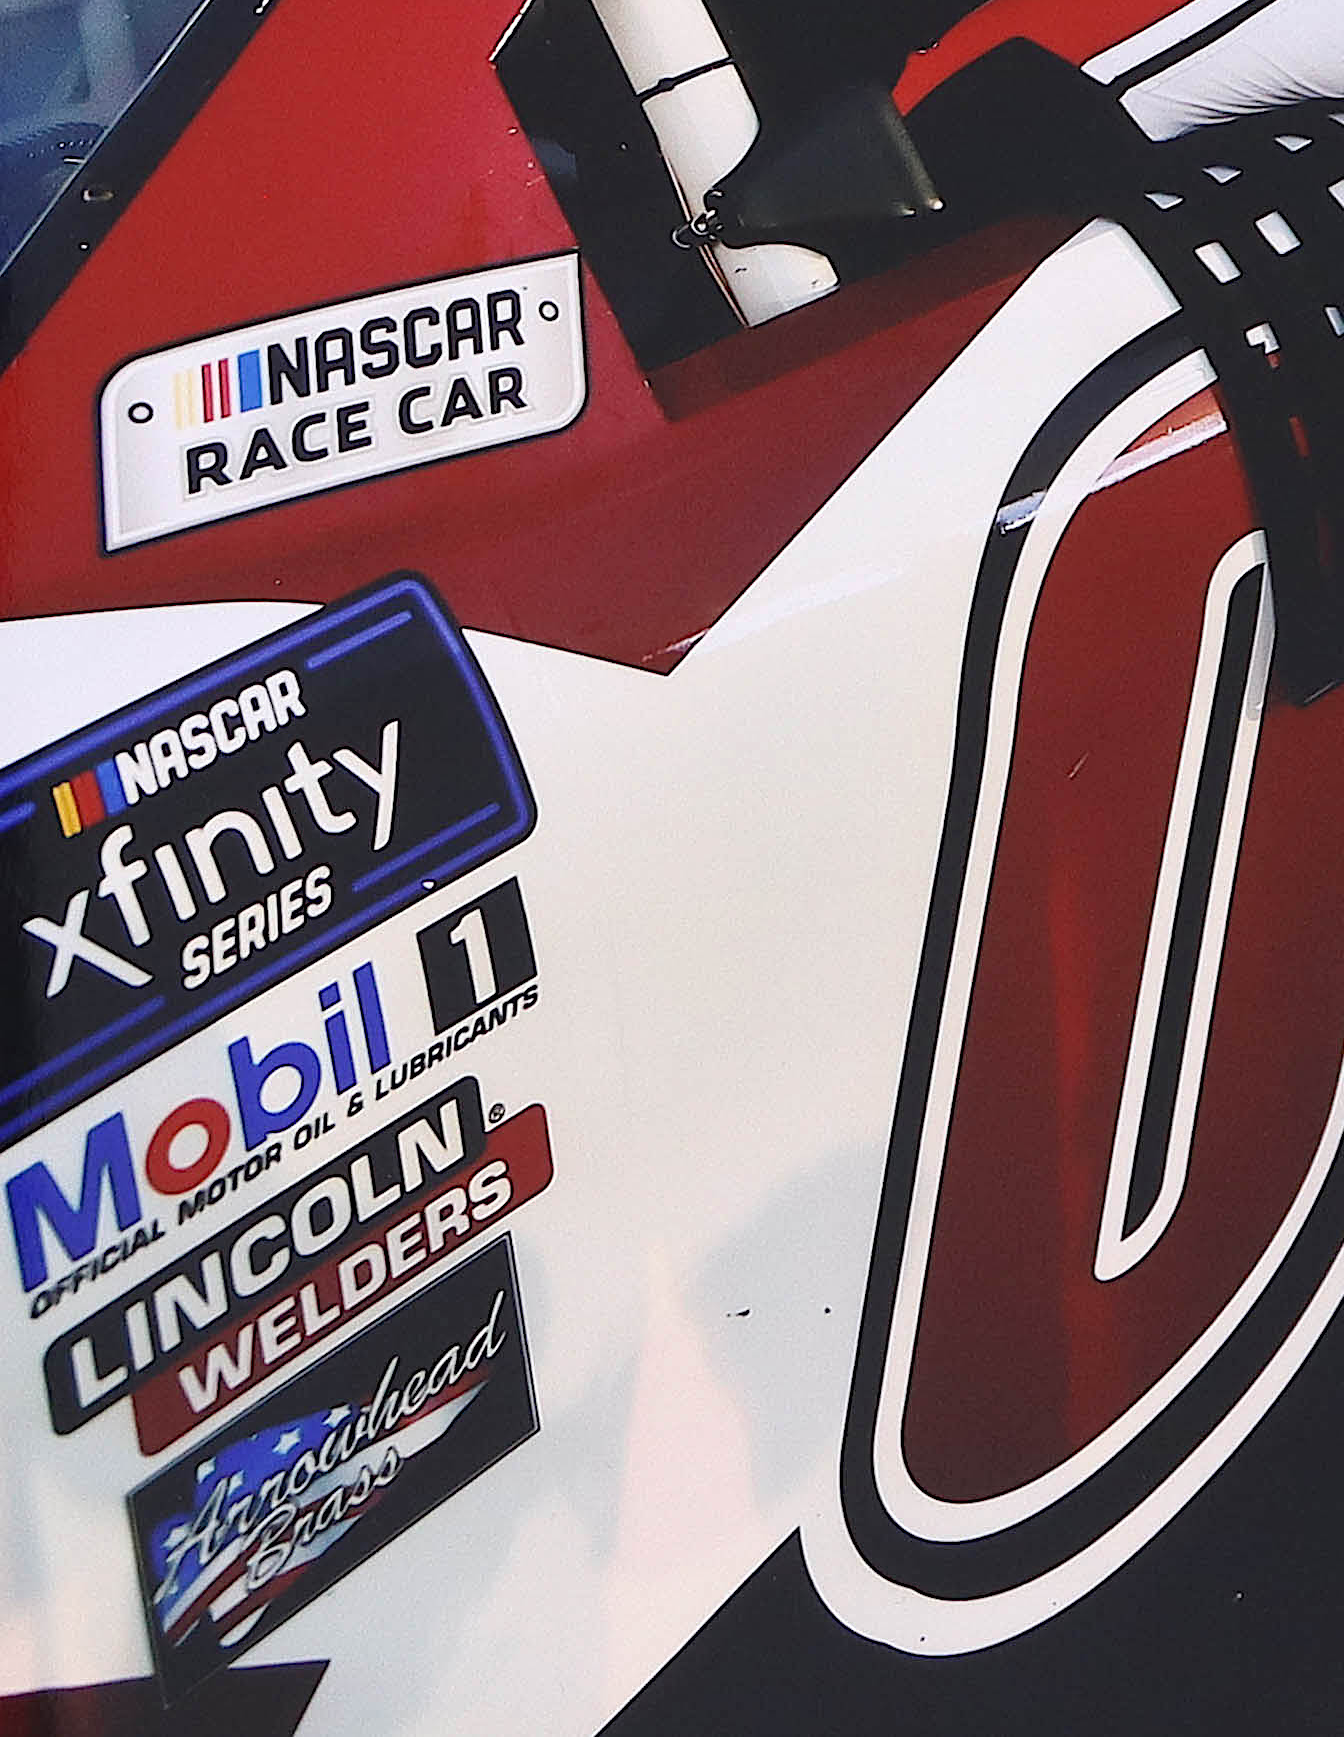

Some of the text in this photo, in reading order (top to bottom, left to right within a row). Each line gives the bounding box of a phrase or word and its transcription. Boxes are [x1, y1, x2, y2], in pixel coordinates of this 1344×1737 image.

[186, 366, 527, 494] RACE CAR
[267, 288, 526, 406] NASCAR
[22, 718, 400, 999] xfinity
[113, 668, 306, 806] NASCAR
[181, 865, 334, 991] SERIES
[5, 907, 499, 1293] Mobil 1
[30, 985, 538, 1319] OFFICIAL MOTOR OIL & LUBRICANTS
[69, 1097, 465, 1408] LINCOLN
[177, 1158, 515, 1415] WELDERS
[152, 1290, 507, 1607] Arrowhead
[246, 1445, 404, 1592] Brass
